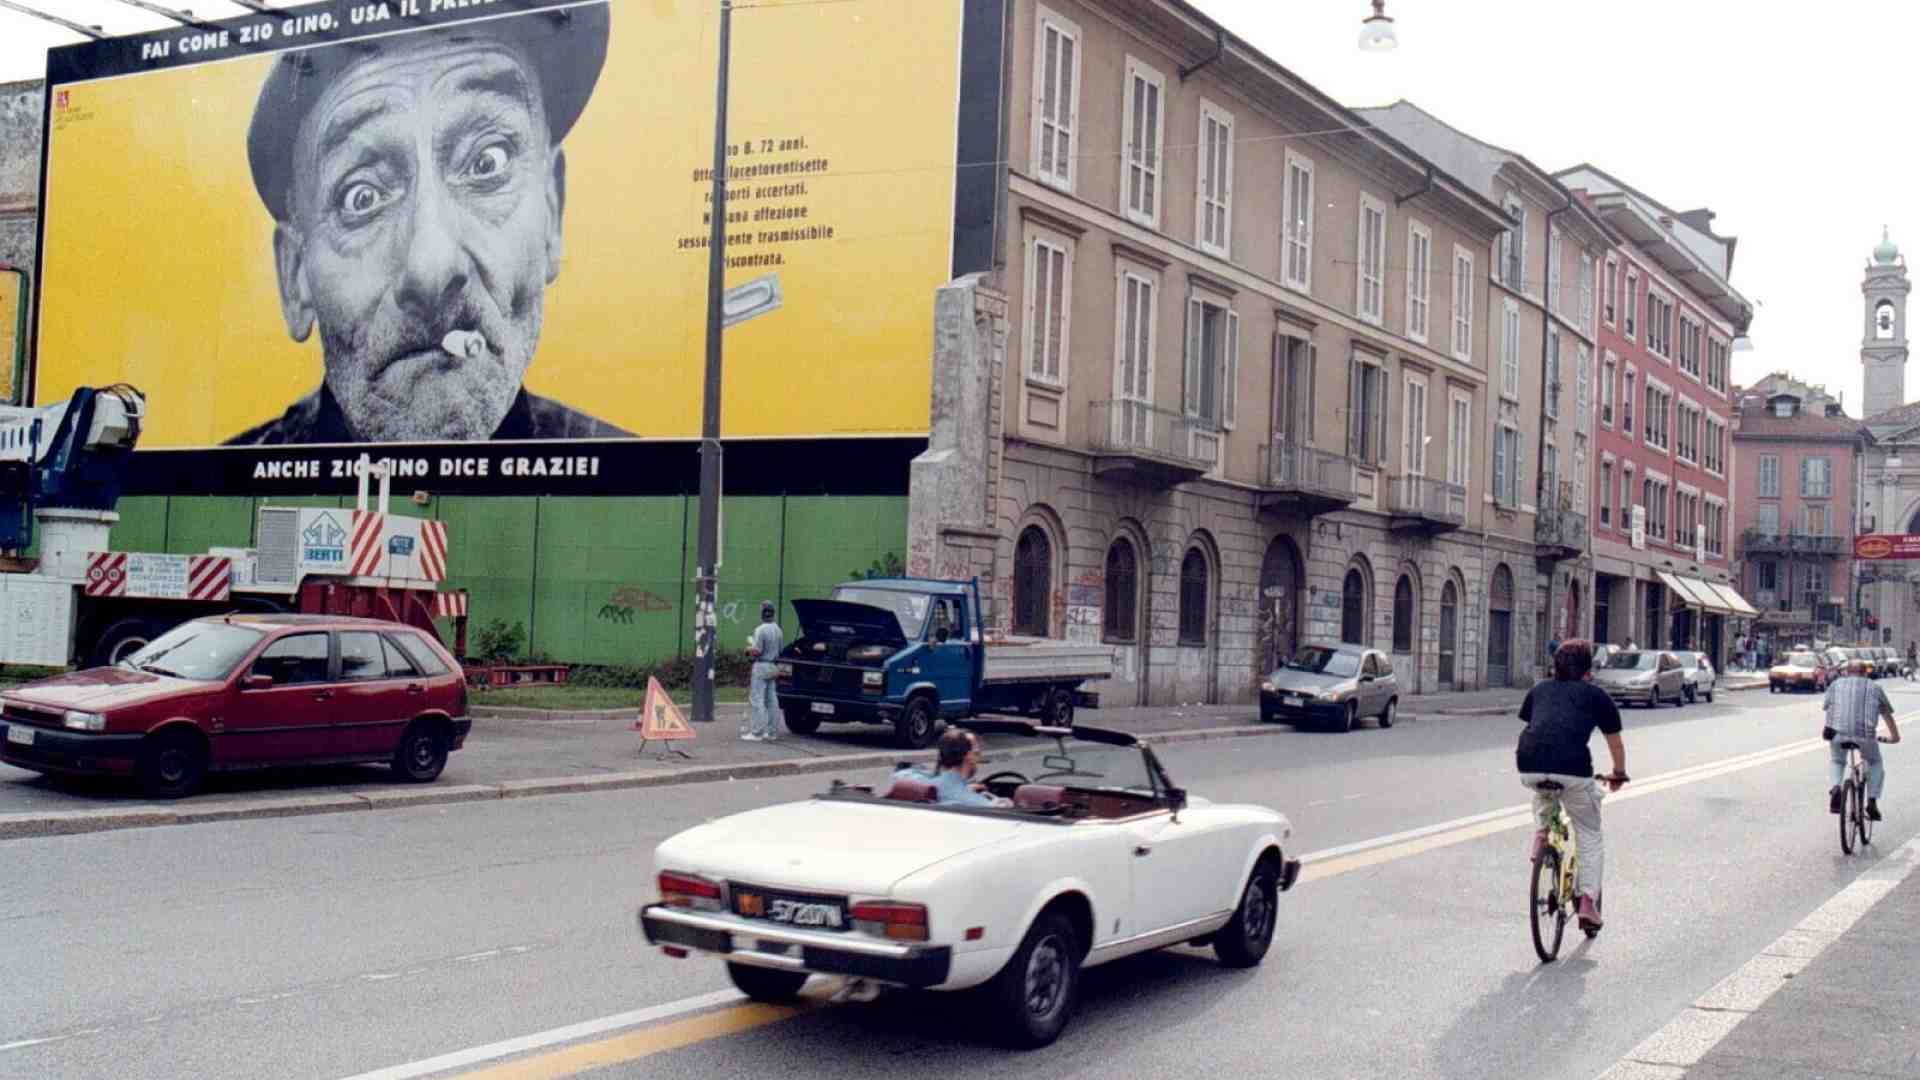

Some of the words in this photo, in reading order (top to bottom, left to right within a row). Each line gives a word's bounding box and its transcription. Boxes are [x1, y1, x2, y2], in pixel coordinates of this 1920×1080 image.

[142, 40, 170, 60] FAI
[178, 31, 229, 53] COME
[239, 23, 273, 44] ZIO
[282, 12, 339, 36] GINO.
[351, 3, 390, 25] USA
[401, 0, 420, 17] IL
[761, 139, 773, 153] 72
[779, 136, 808, 151] anni.
[755, 182, 808, 200] accertati.
[754, 206, 808, 221] affezione
[758, 226, 833, 244] trasmissibile
[726, 253, 785, 269] iscontrata.
[253, 460, 320, 478] ANCHE
[380, 458, 429, 477] INO
[440, 457, 489, 477] DICE
[304, 548, 343, 561] BERTI
